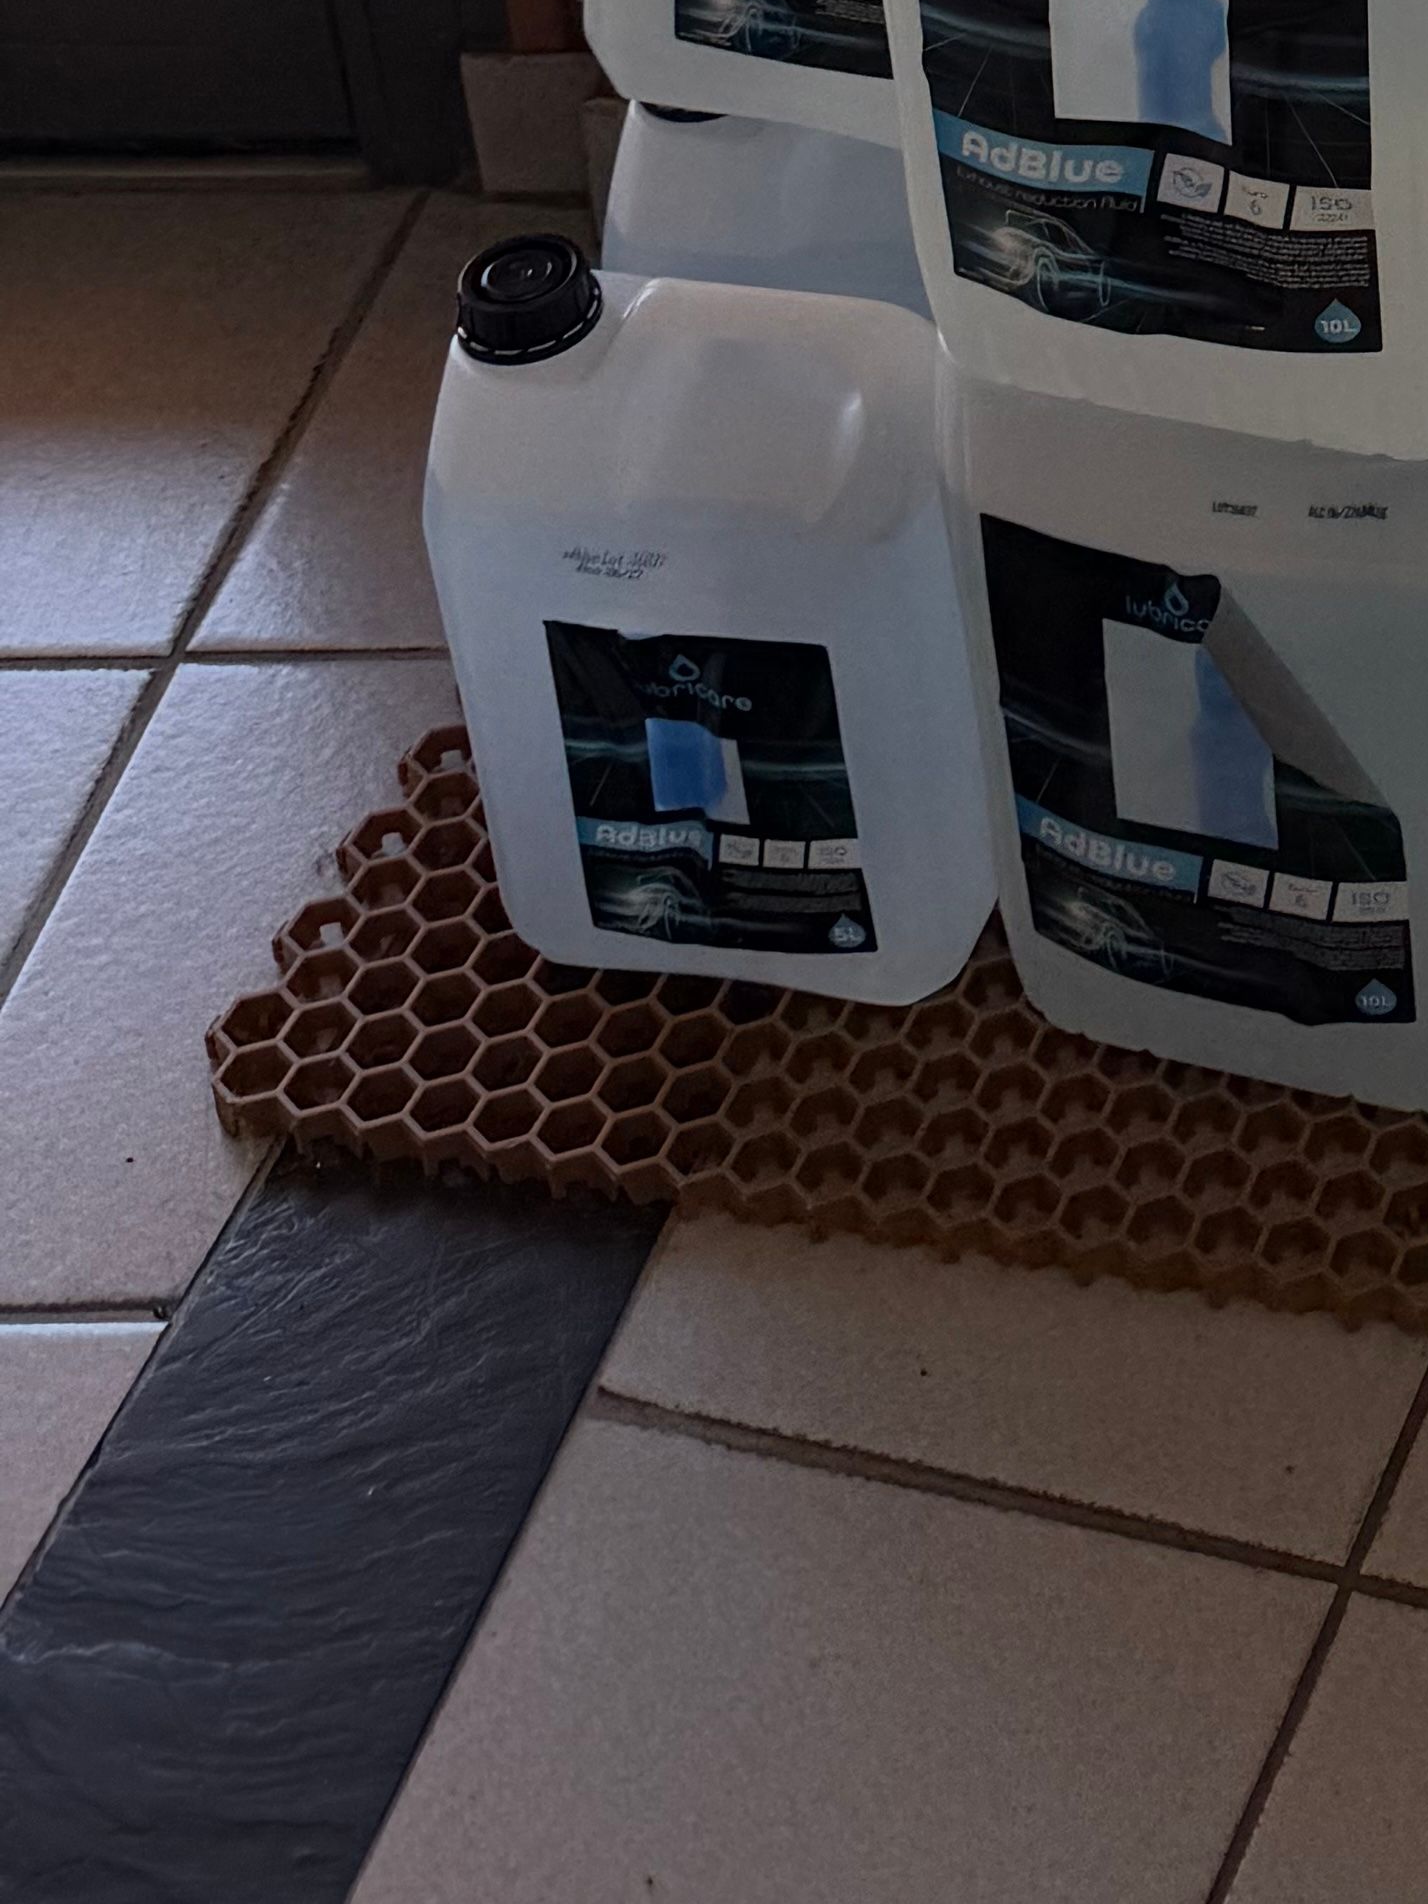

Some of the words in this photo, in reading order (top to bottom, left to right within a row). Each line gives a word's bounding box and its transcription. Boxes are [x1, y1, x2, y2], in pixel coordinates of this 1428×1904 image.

[959, 130, 1126, 185] AdBlue
[1309, 194, 1353, 213] ISO
[1317, 318, 1357, 336] 10L
[1039, 816, 1177, 882] AdBlue
[1358, 994, 1393, 1009] 10L
